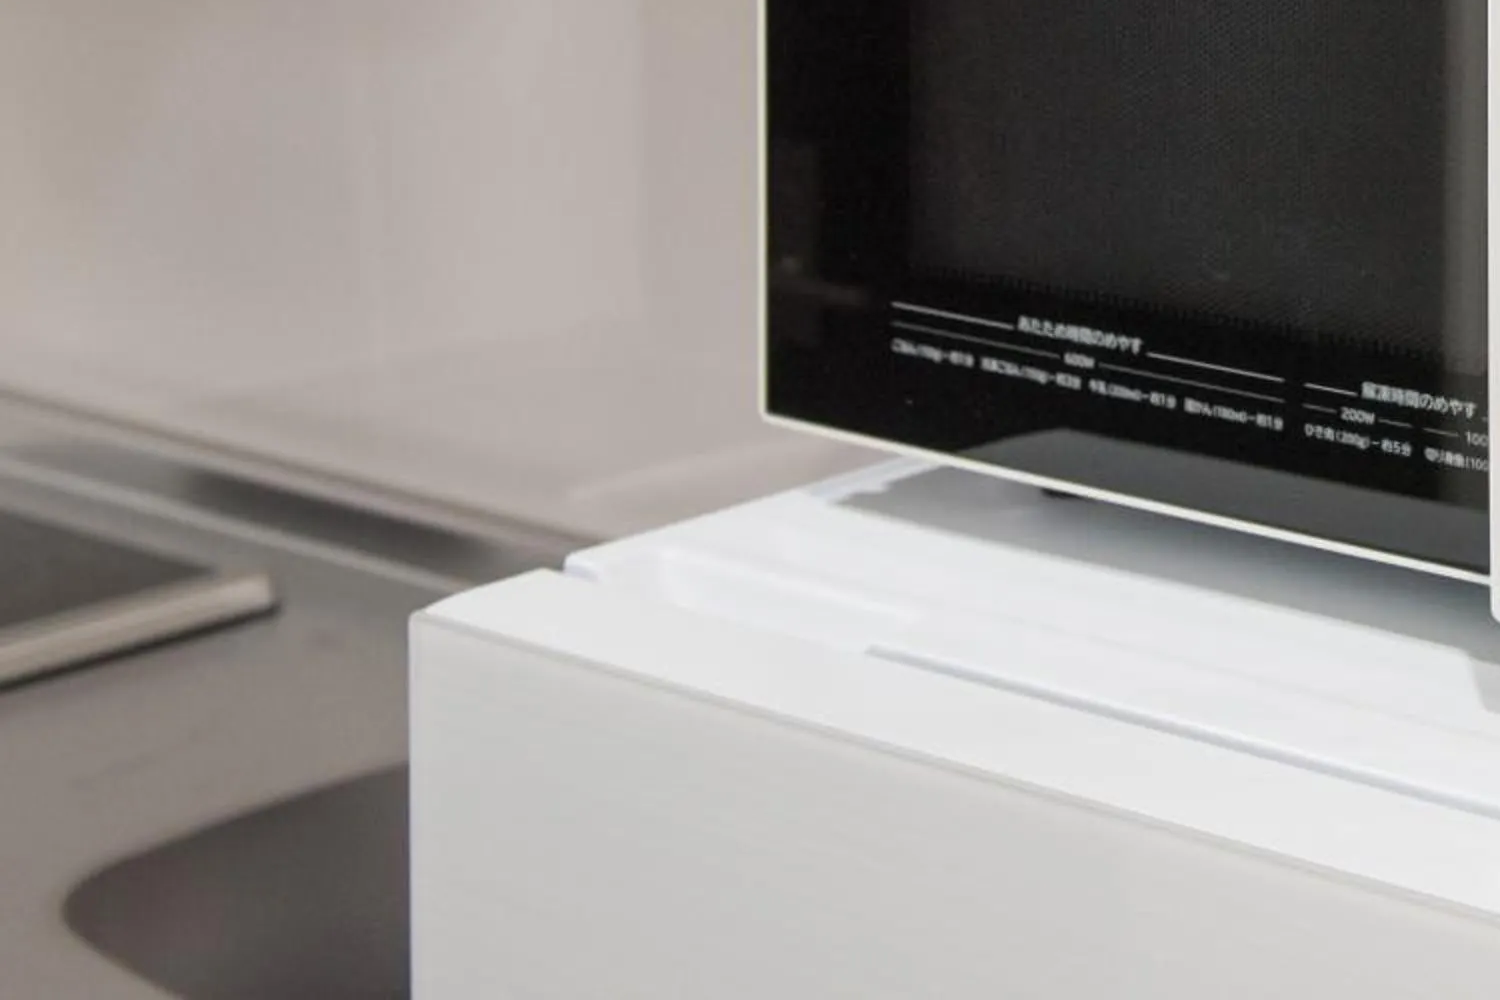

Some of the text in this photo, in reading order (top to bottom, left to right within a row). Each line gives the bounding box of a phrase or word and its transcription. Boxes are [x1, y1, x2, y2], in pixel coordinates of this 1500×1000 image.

[1361, 382, 1476, 420] 解凍時間のめやす
[1341, 407, 1375, 425] 200W
